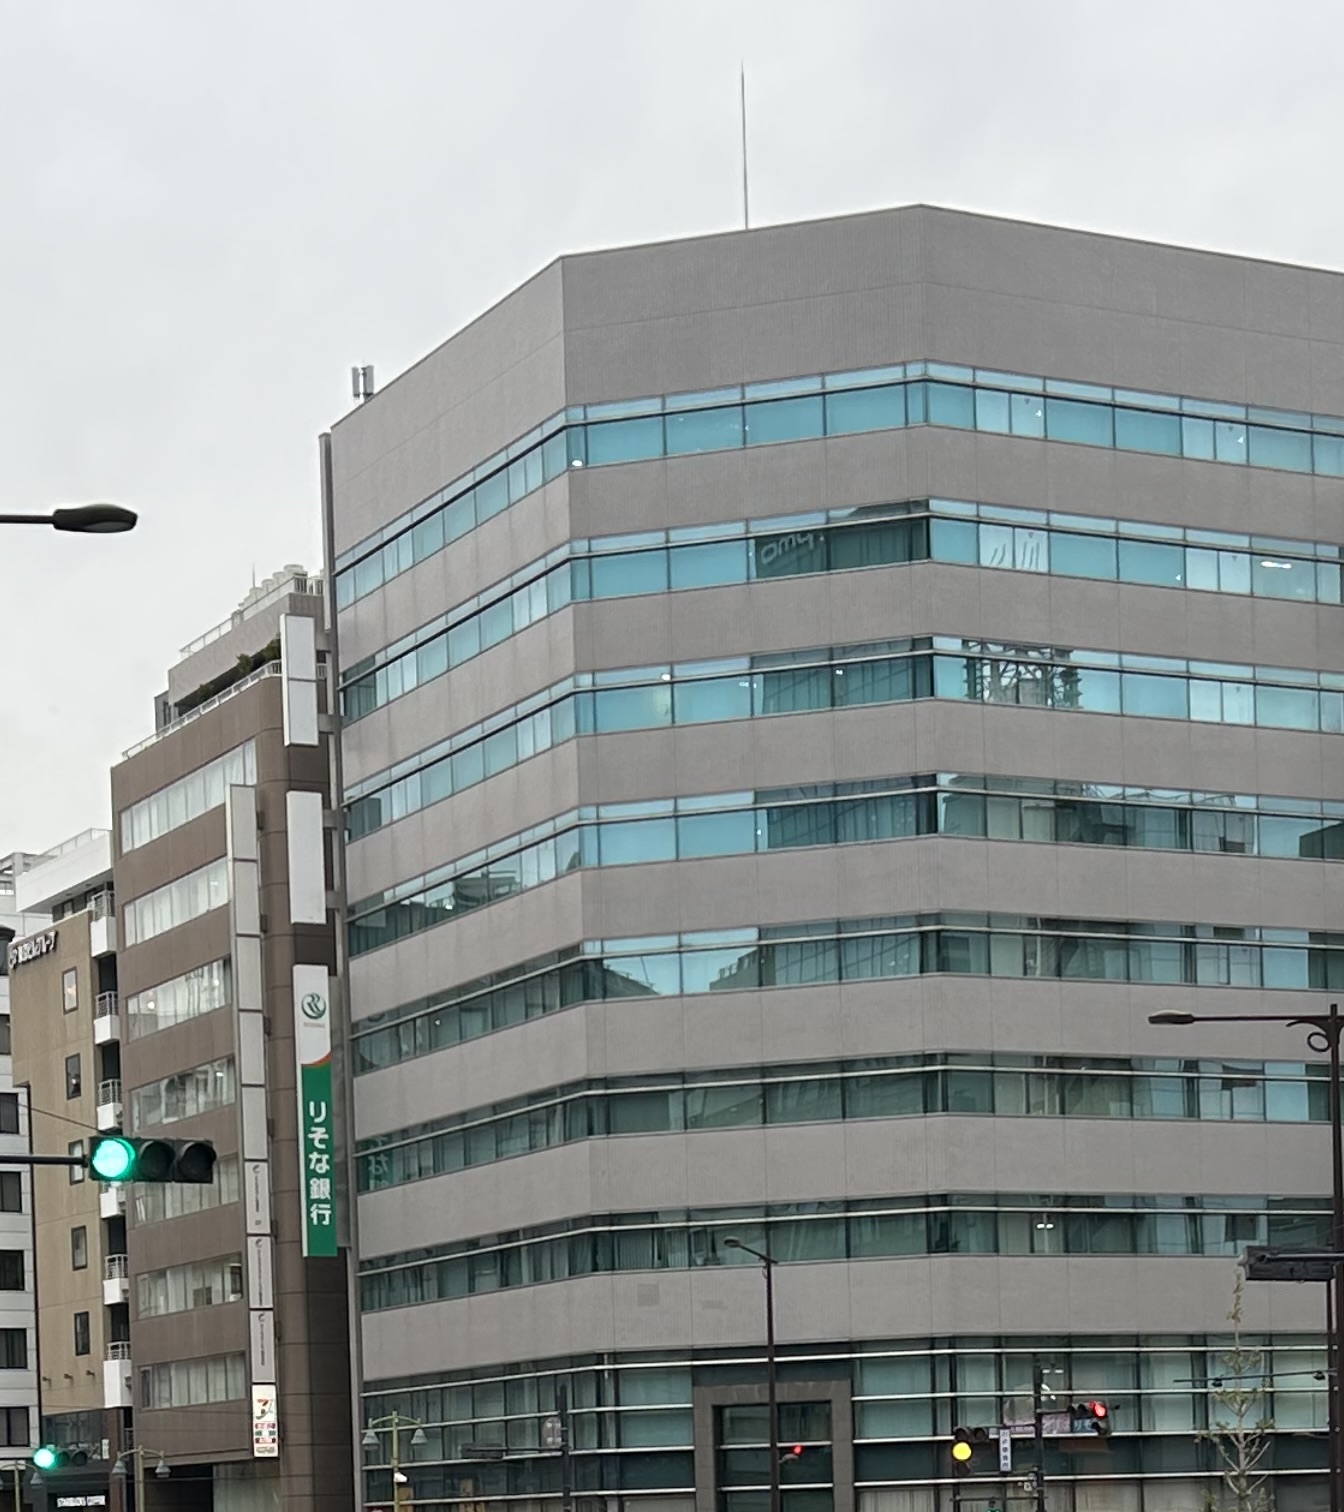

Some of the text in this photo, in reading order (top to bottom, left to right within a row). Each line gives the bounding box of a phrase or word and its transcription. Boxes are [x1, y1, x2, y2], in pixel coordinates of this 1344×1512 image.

[308, 1101, 332, 1226] りそな銀行
